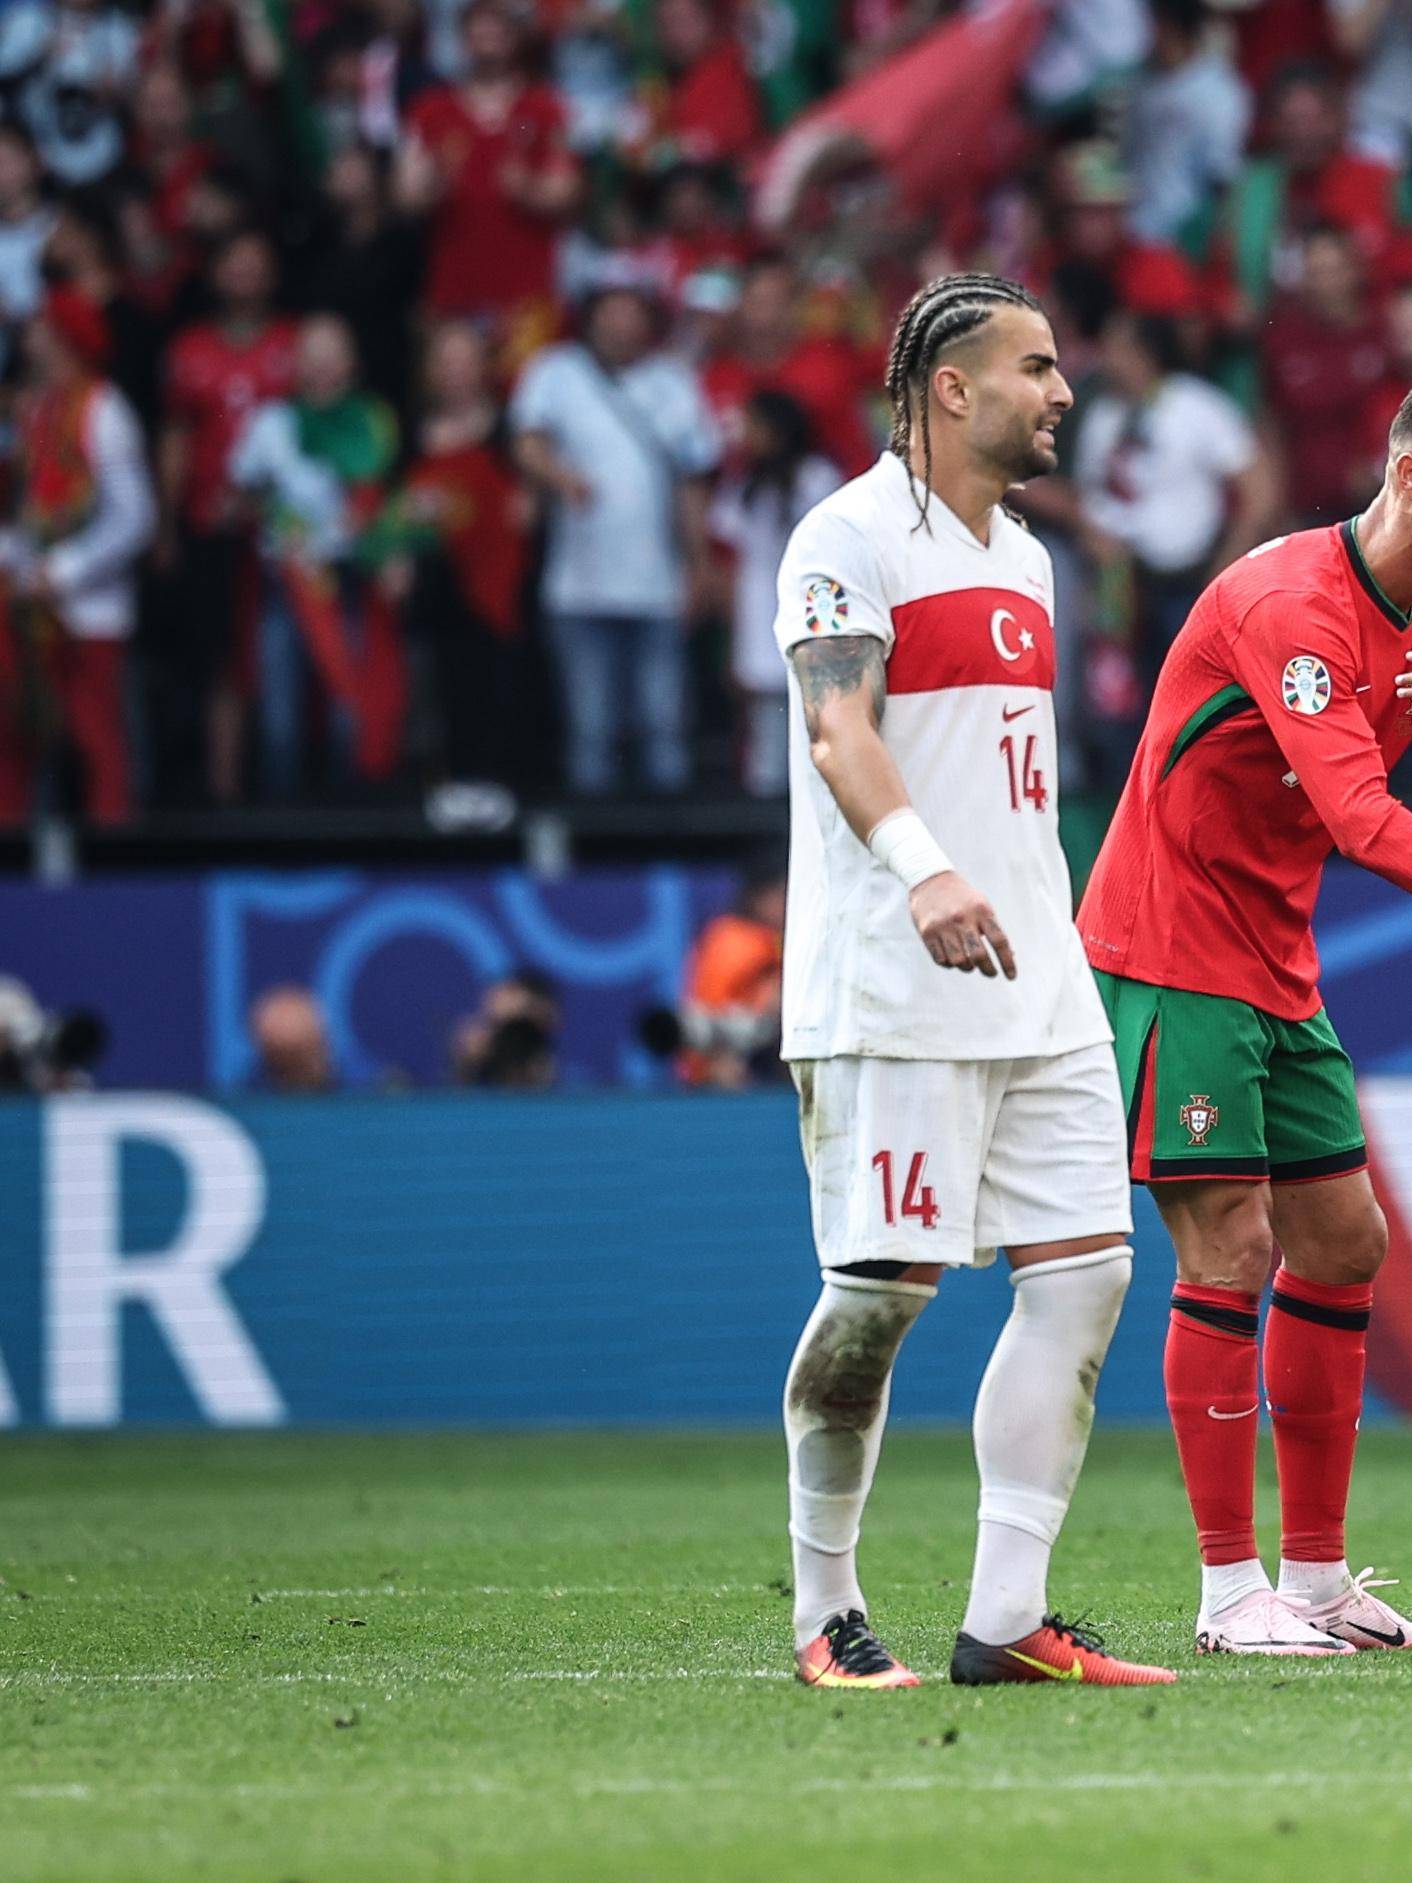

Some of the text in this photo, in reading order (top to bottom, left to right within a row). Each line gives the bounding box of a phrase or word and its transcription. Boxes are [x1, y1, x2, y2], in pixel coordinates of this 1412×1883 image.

[999, 735, 1048, 813] 14
[872, 1150, 941, 1230] 14
[0, 1090, 290, 1428] R
